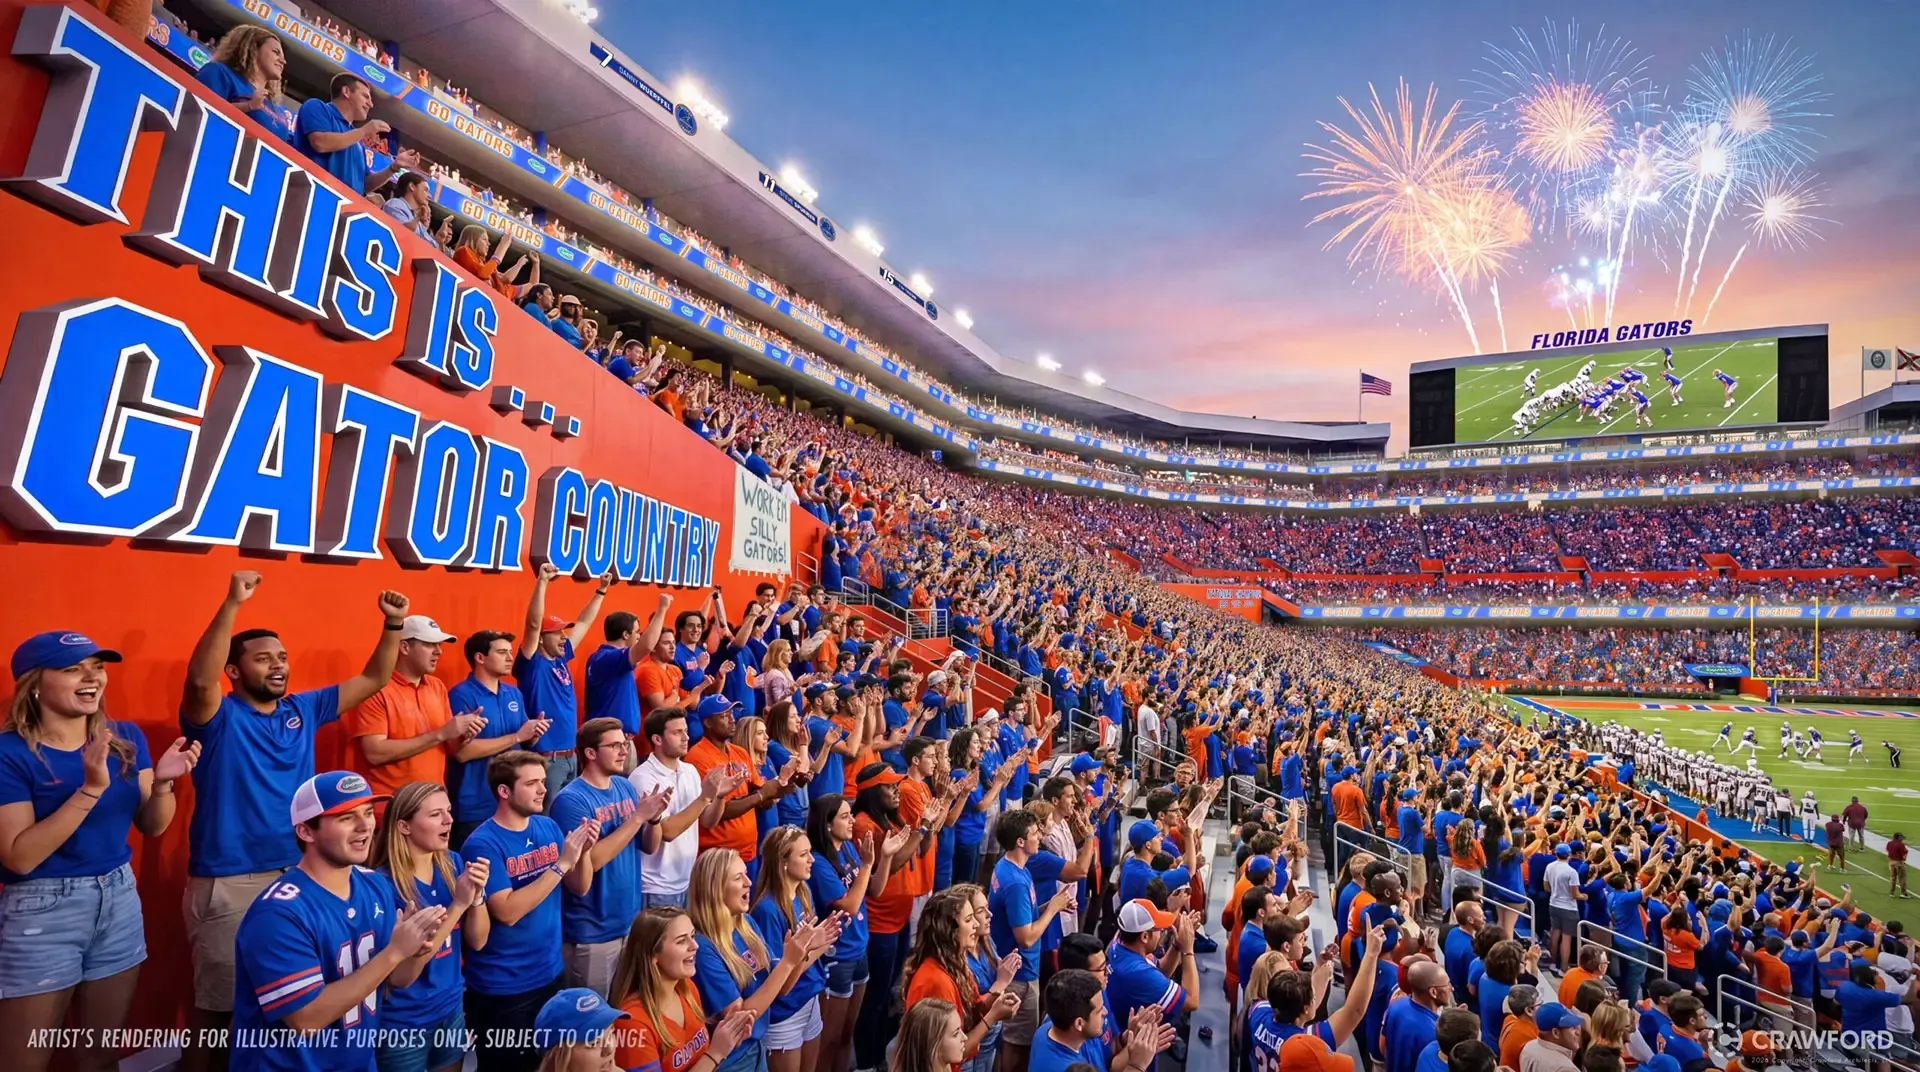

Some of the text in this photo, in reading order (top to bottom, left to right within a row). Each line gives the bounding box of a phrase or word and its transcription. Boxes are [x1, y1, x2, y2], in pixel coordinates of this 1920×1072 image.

[243, 0, 346, 62] GO GATORS
[600, 46, 614, 68] 7
[427, 100, 513, 158] GO GATORS
[38, 8, 401, 341] THIS
[763, 174, 776, 193] 11
[462, 199, 544, 249] GO GATORS
[589, 191, 650, 235] GO GATORS
[615, 272, 672, 310] GO GATORS
[719, 265, 749, 290] GATORS
[883, 269, 895, 285] 15
[723, 325, 766, 353] GO GATORS
[1531, 319, 1693, 350] FLORIDA GATORS
[11, 297, 721, 588] GATOR COUNTRY
[741, 472, 775, 518] WORK
[743, 539, 787, 565] GATORS!
